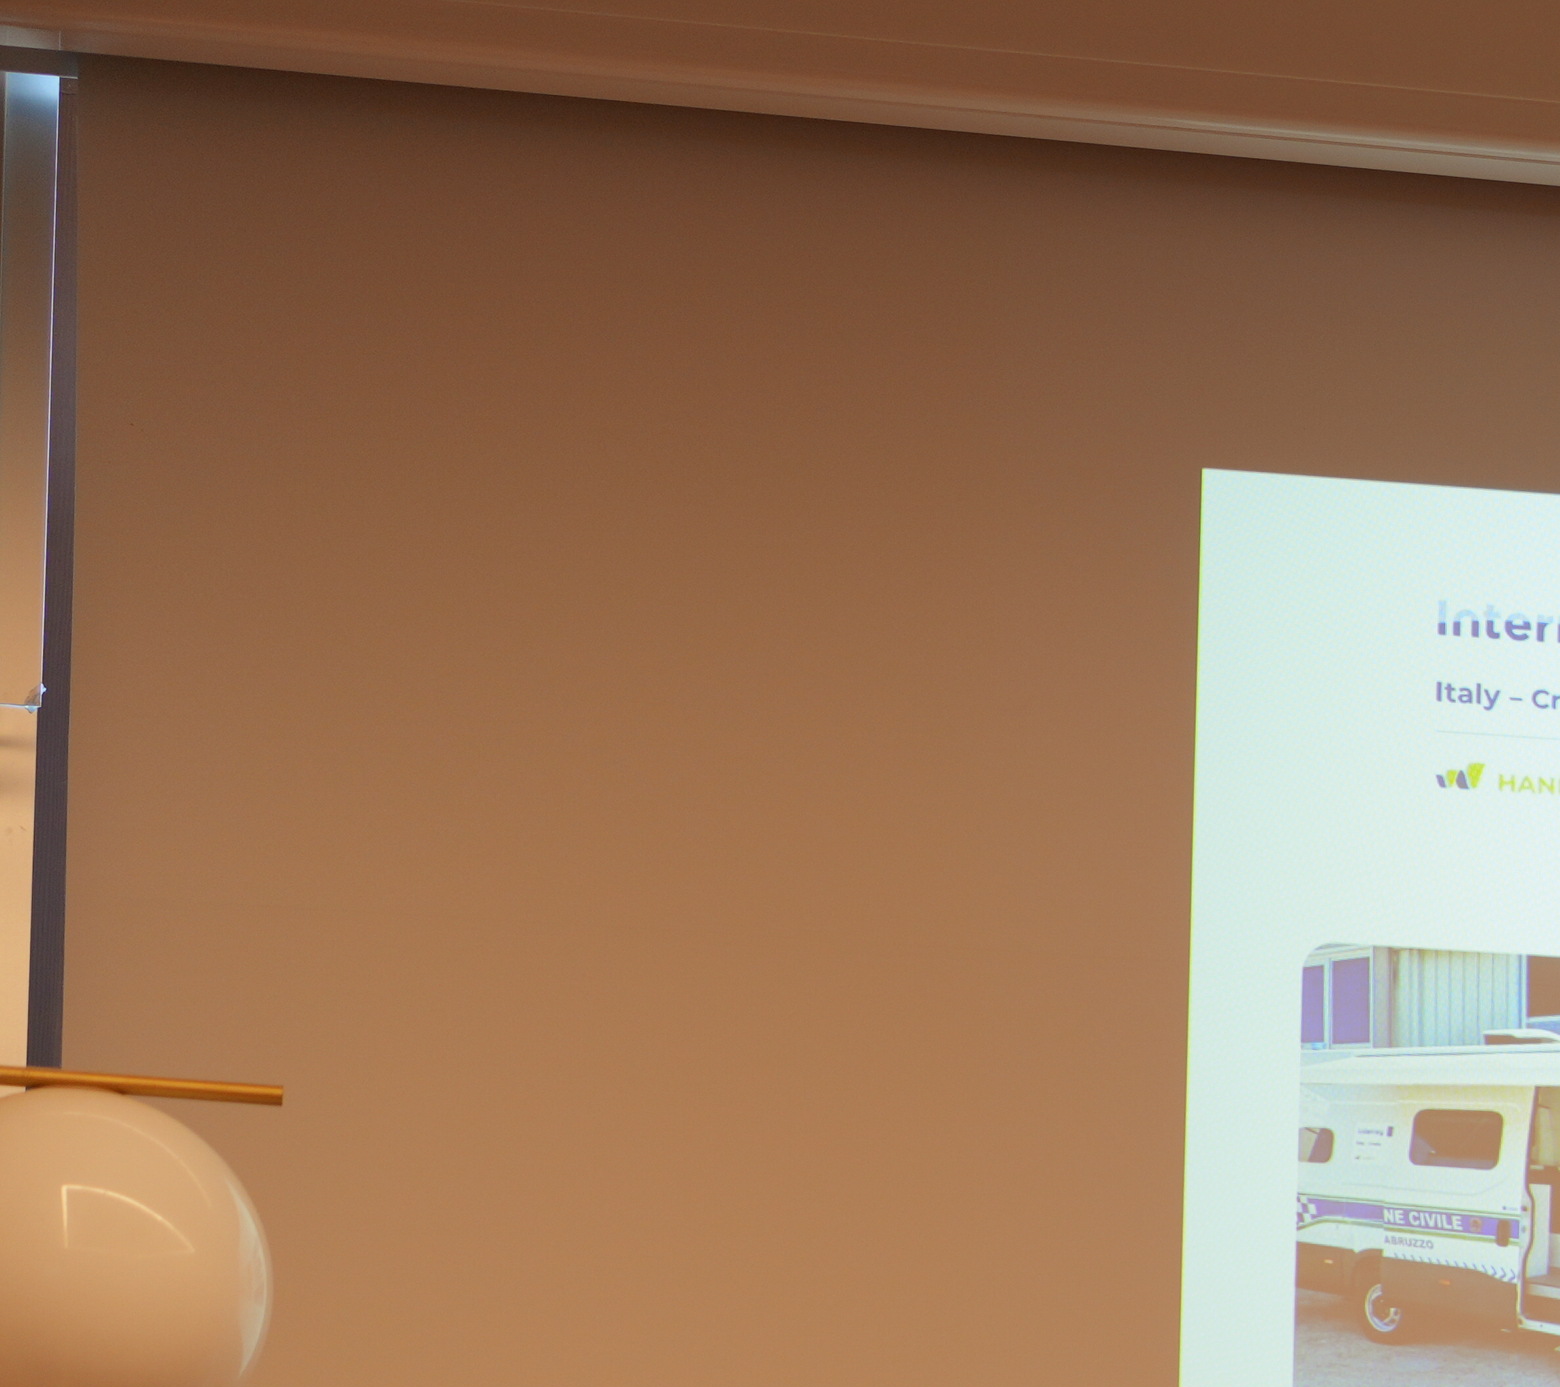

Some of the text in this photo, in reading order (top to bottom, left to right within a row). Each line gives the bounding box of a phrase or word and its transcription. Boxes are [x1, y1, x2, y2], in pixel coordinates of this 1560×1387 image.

[1435, 681, 1500, 711] Italy
[1408, 1211, 1464, 1231] CIVILE
[1384, 1235, 1434, 1250] ABRUZZO
